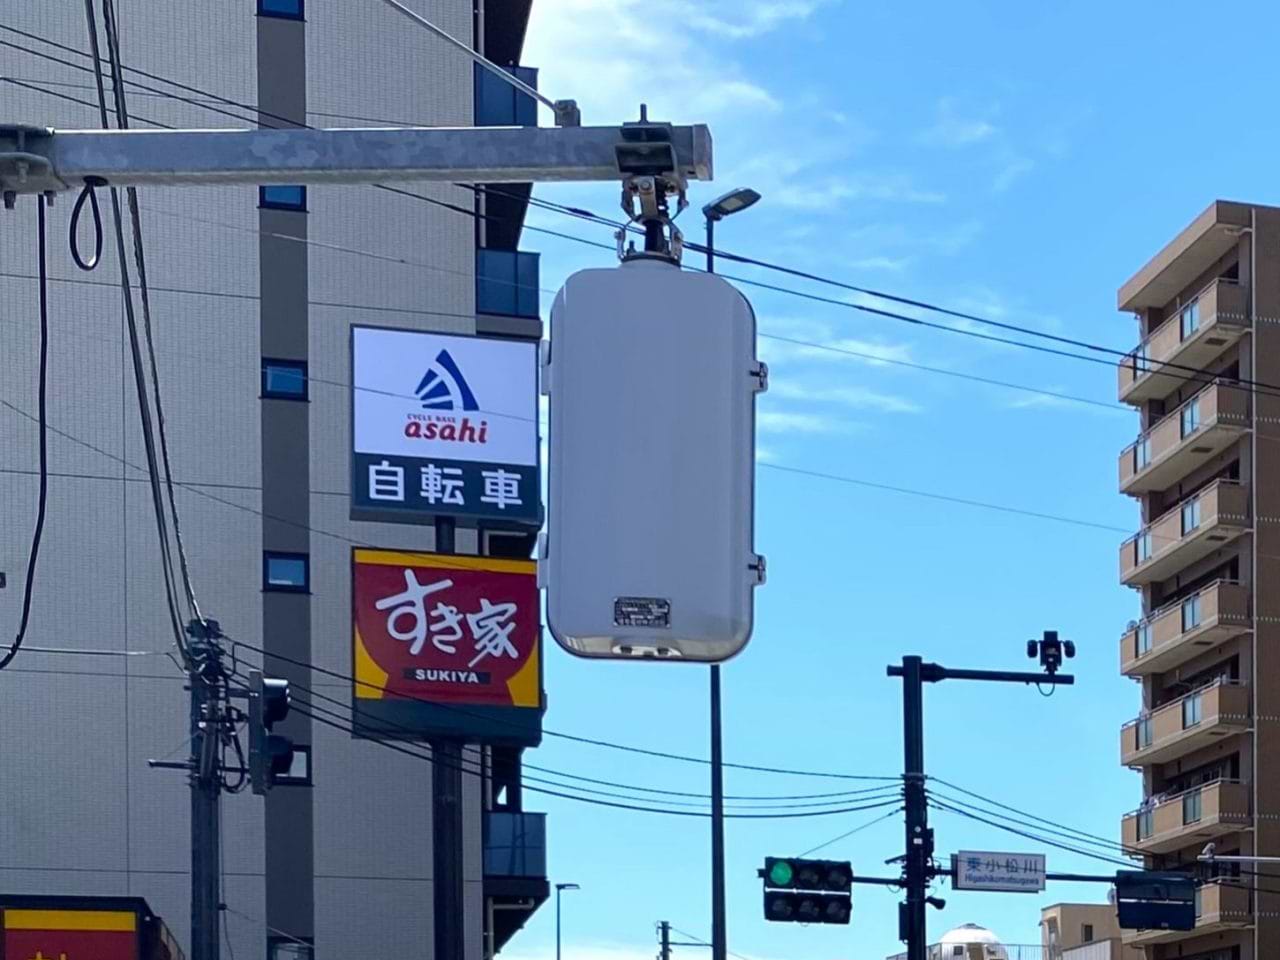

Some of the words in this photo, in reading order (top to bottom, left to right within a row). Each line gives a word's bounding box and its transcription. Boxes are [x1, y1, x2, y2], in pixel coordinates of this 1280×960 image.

[407, 413, 432, 422] CYCLE
[404, 417, 487, 444] asahi
[368, 460, 523, 510] 自転車
[375, 568, 519, 667] すき家
[415, 669, 479, 683] SUKIYA
[967, 857, 1037, 874] 東小松川
